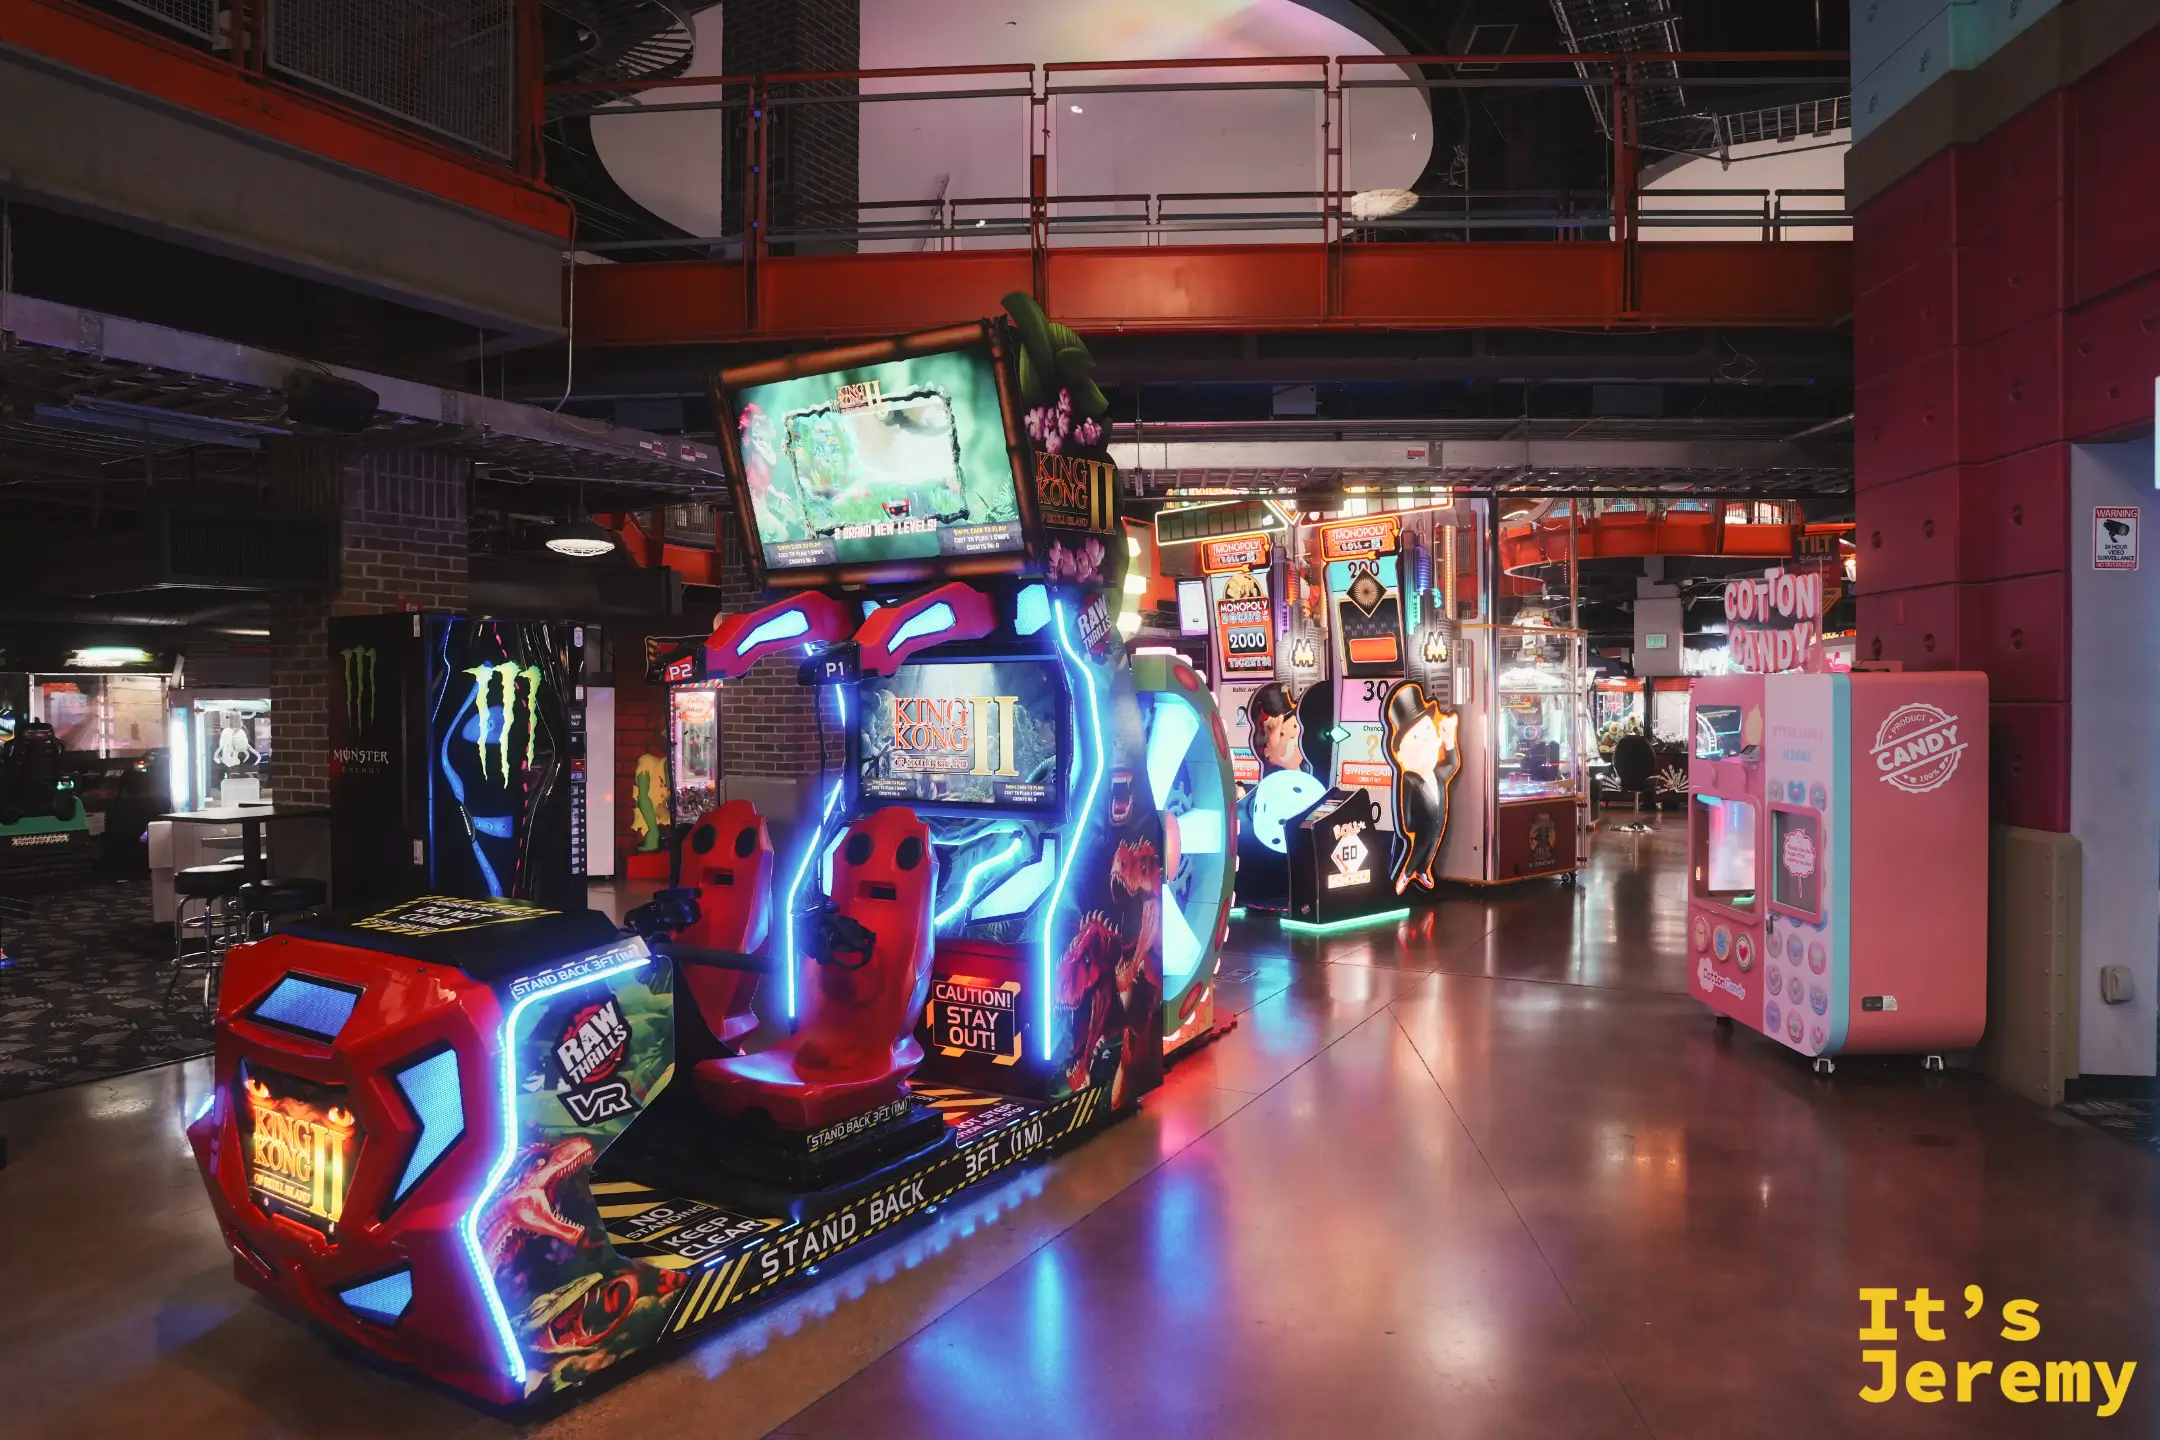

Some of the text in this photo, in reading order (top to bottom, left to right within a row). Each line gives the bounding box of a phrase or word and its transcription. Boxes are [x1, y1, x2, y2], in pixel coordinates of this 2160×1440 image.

[1035, 451, 1087, 486] KING
[1036, 478, 1088, 509] KONG
[1087, 460, 1116, 535] II
[2096, 509, 2137, 518] WARNING
[843, 525, 871, 539] BRAND
[875, 523, 894, 536] NEW
[898, 519, 937, 534] LEVELS!
[1335, 525, 1385, 540] MONOPOLY
[1215, 540, 1259, 554] MONOPOLY
[1798, 535, 1832, 553] TILT
[1221, 600, 1268, 612] MONOPOLY
[1724, 567, 1819, 623] COTTON
[1077, 594, 1108, 640] RAW
[1222, 610, 1261, 624] BONUS
[1083, 614, 1111, 651] THRILLS
[1229, 632, 1265, 649] 2000
[1729, 621, 1813, 674] CANDY
[669, 663, 692, 680] P2
[826, 661, 844, 677] P1
[1363, 680, 1390, 701] 30
[892, 697, 968, 726] KING
[969, 696, 1019, 776] II
[1891, 714, 1926, 734] PRODUCT
[893, 725, 968, 751] KONG
[1877, 724, 1957, 771] CANDY
[333, 747, 389, 764] MONSTER
[341, 766, 381, 774] ENERGY
[1344, 765, 1371, 776] SWIPE
[1920, 768, 1940, 782] 100%
[1343, 845, 1357, 861] GO
[399, 914, 460, 926] CLIMB
[415, 906, 446, 915] DO
[446, 908, 494, 920] NOT
[513, 975, 557, 995] STAND
[558, 965, 592, 980] BACK
[592, 956, 615, 970] 3FT
[1704, 968, 1725, 988] Cotton
[936, 984, 1010, 1008] CAUTION!
[946, 1006, 999, 1030] STAY
[557, 1000, 619, 1072] RAW
[949, 1026, 995, 1050] OUT!
[569, 1024, 627, 1084] THRILLS
[566, 1083, 632, 1121] VR
[253, 1105, 311, 1152] KING
[811, 1099, 907, 1148] STAND BACK 3FT (1M)
[253, 1132, 311, 1182] KONG
[254, 1173, 263, 1185] OF
[310, 1123, 346, 1223] II
[761, 1120, 1043, 1279] STAND BACK 3FT (1M)
[626, 1204, 707, 1239] STANDING
[629, 1208, 674, 1227] NO
[662, 1216, 729, 1247] KEEP
[679, 1220, 765, 1257] CLEAR
